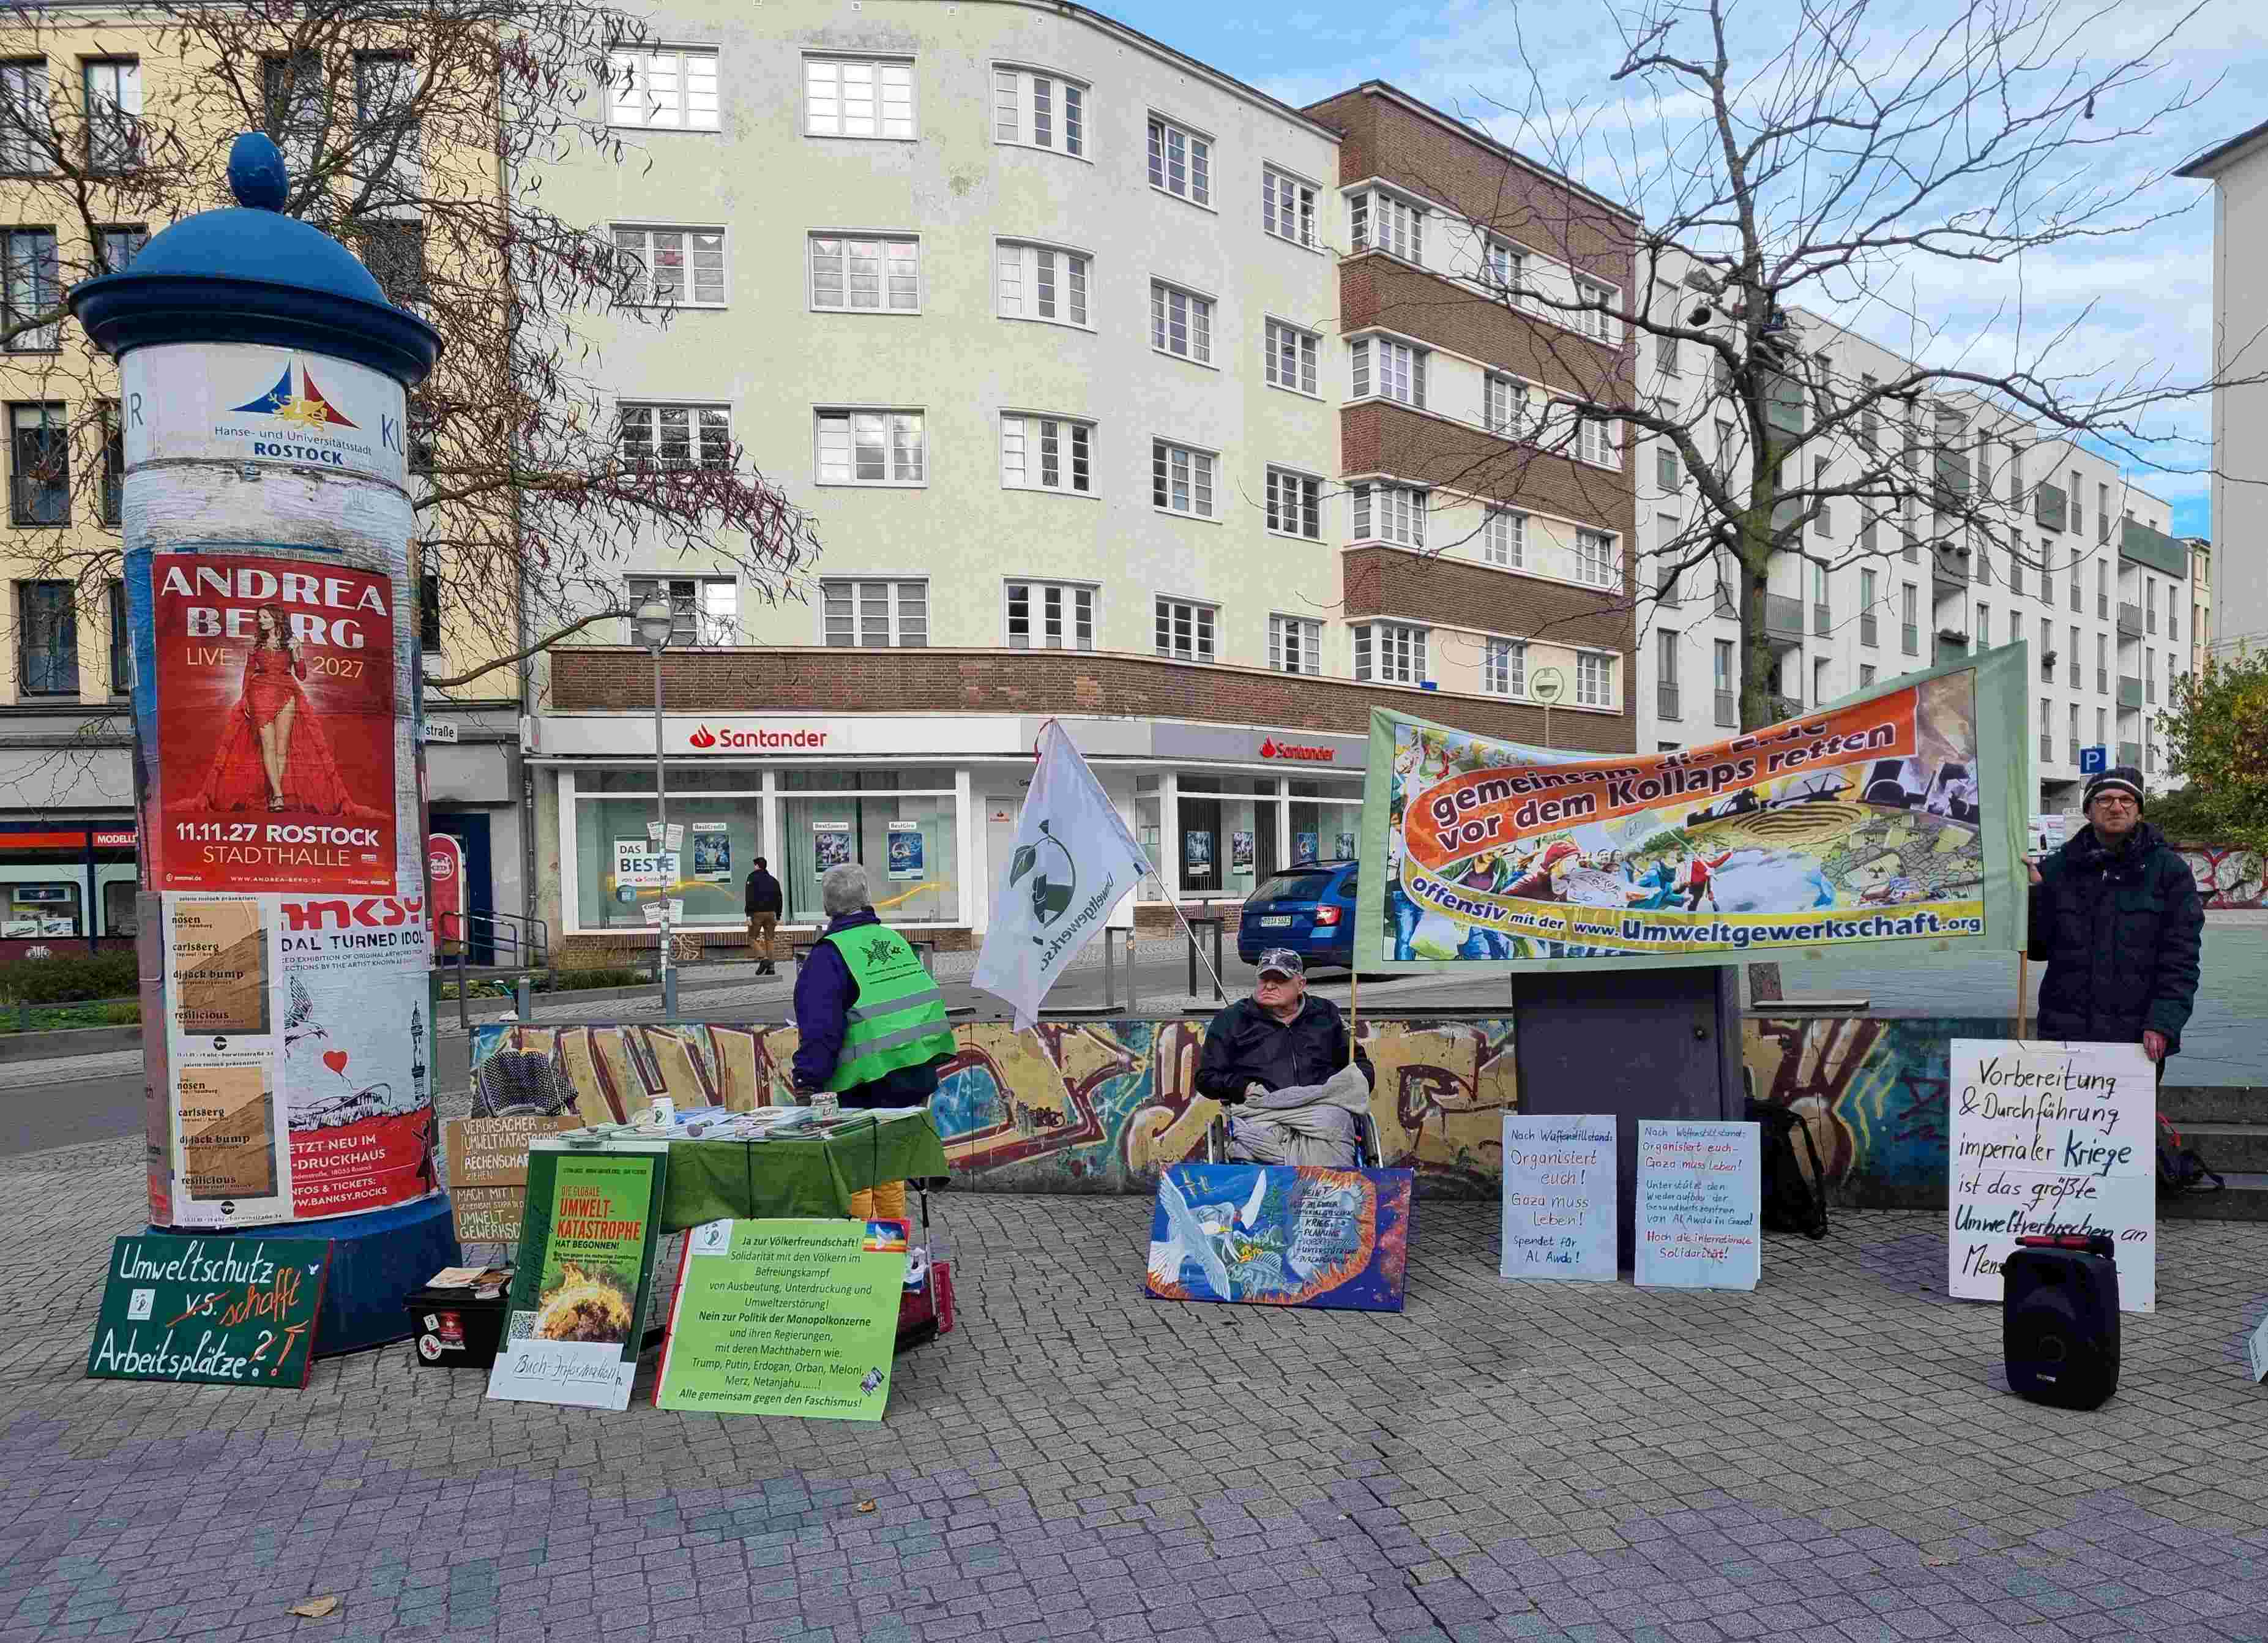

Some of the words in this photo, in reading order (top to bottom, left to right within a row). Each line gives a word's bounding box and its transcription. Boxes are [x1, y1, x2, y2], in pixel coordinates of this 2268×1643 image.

[215, 425, 255, 436] Hanse-
[259, 430, 283, 440] und
[254, 441, 343, 465] ROSTOCK
[161, 566, 387, 616] ANDREA
[187, 607, 364, 649] BERG
[186, 648, 234, 667] LIVE
[312, 656, 364, 679] 2027
[719, 729, 827, 747] Santander
[1276, 741, 1337, 761] Santander
[2086, 752, 2100, 769] P
[1436, 813, 1503, 851] vor
[1513, 789, 1595, 829] dem
[1605, 758, 1758, 808] Kollaps
[1767, 722, 1897, 774] retten
[1431, 766, 1641, 828] gemeinsam
[176, 822, 258, 842] 11.11.27
[266, 824, 379, 847] ROSTOCK
[203, 846, 351, 866] STADTHALLE
[619, 845, 641, 854] DAS
[1412, 875, 1508, 921] offensiv
[1510, 912, 1534, 926] mit
[1537, 914, 1565, 930] der
[329, 932, 398, 949] TURNED
[401, 930, 424, 946] IDOL
[297, 954, 340, 963] EXHIBITION
[1980, 1057, 2117, 1099] Vorbereitung
[1959, 1086, 1981, 1116] &
[1982, 1092, 2121, 1135] Durchführung
[463, 1117, 537, 1135] VERURSACHER
[1644, 1126, 1668, 1137] Nach
[329, 1137, 357, 1151] NEU
[362, 1134, 376, 1146] IM
[1511, 1128, 1535, 1141] Nach
[1643, 1141, 1701, 1155] Organisiert
[1959, 1132, 2056, 1168] imperialer
[2064, 1129, 2132, 1177] Kriege
[1510, 1149, 1597, 1170] Organisiert
[1646, 1156, 1676, 1168] Gaza
[1682, 1161, 1706, 1170] muss
[332, 1177, 376, 1191] TICKETS:
[573, 1185, 600, 1196] GLOBALE
[1707, 1182, 1726, 1191] den
[1958, 1172, 1982, 1194] ist
[1987, 1172, 2021, 1195] das
[2022, 1176, 2098, 1211] größte
[456, 1188, 485, 1202] MACH
[489, 1187, 509, 1199] MIT
[1512, 1192, 1545, 1206] Gaza
[1551, 1194, 1590, 1208] muss
[1712, 1194, 1729, 1203] der
[559, 1197, 615, 1218] UMWELT-
[1647, 1214, 1666, 1224] von
[558, 1219, 642, 1241] KATASTROPHE
[1646, 1230, 1672, 1242] Hoch
[1676, 1232, 1693, 1242] die
[2121, 1229, 2149, 1243] an
[554, 1239, 572, 1249] HAT
[572, 1240, 620, 1250] BEGONNEN!
[742, 1236, 752, 1246] Ja
[769, 1236, 859, 1248] Völkerfreundschaft!
[1513, 1235, 1555, 1249] Spendet
[120, 1239, 274, 1284] Umweltschutz
[731, 1251, 774, 1261] Solidarität
[776, 1252, 792, 1262] mit
[793, 1252, 810, 1262] den
[813, 1253, 847, 1263] Völkern
[849, 1254, 861, 1263] im
[755, 1267, 830, 1279] Befreiungskampf
[709, 1282, 725, 1290] von
[726, 1281, 783, 1294] Ausbeutung,
[854, 1285, 872, 1295] und
[218, 1267, 300, 1327] schafft
[744, 1297, 829, 1311] Umweltzerstörung!
[698, 1311, 720, 1322] Nein
[722, 1314, 736, 1322] zur
[738, 1312, 766, 1323] Politik
[769, 1312, 783, 1323] der
[786, 1314, 871, 1327] Monopolkonzerne
[729, 1328, 747, 1339] und
[748, 1328, 772, 1339] ihren
[774, 1330, 833, 1343] Regierungen,
[714, 1343, 729, 1353] mit
[732, 1343, 758, 1355] deren
[760, 1345, 821, 1358] Machthabern
[824, 1348, 843, 1358] wie:
[692, 1357, 723, 1371] Trump,
[725, 1359, 750, 1371] Putin,
[753, 1360, 793, 1374] Erdogan,
[794, 1361, 827, 1375] Orban,
[829, 1363, 865, 1377] Meloni,
[725, 1375, 750, 1387] Merz,
[679, 1388, 697, 1399] Alle
[698, 1390, 752, 1402] gemeinsam
[753, 1394, 781, 1405] gegen
[784, 1394, 802, 1405] den
[804, 1396, 862, 1408] Faschismus!
